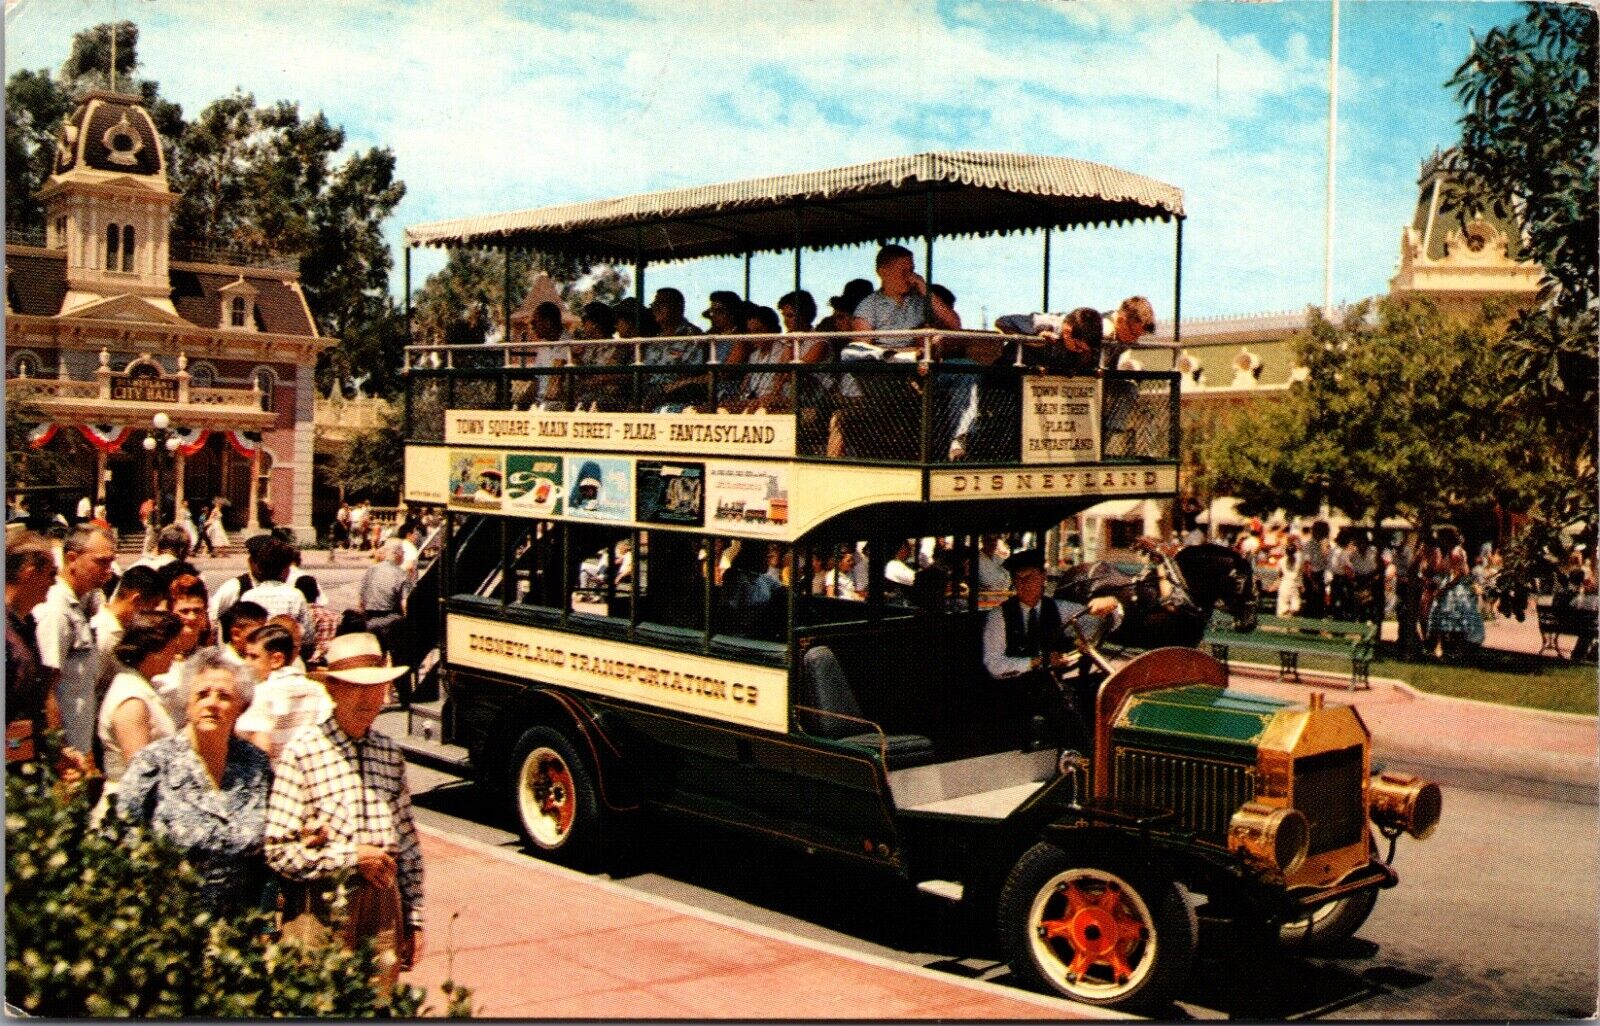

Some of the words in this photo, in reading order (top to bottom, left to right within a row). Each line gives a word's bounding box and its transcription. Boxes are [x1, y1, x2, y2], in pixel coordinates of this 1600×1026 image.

[114, 387, 141, 399] CITY
[146, 388, 176, 401] HALL
[1031, 386, 1058, 397] TOWN
[1062, 386, 1095, 398] SQUARE
[1034, 403, 1058, 414] MAIN
[1061, 403, 1090, 415] STREET
[456, 419, 484, 434] TOWN
[489, 420, 530, 437] SQUARE
[538, 421, 568, 437] MAIN
[573, 422, 613, 438] STREET
[623, 423, 656, 440] PLAZA
[670, 424, 775, 444] FANTASYLAND
[1029, 438, 1094, 451] FANTASYLAND
[953, 472, 1157, 491] DISNEYLAND
[469, 634, 564, 667] DISNEYLAND
[570, 652, 726, 699] TRANSPORTATION
